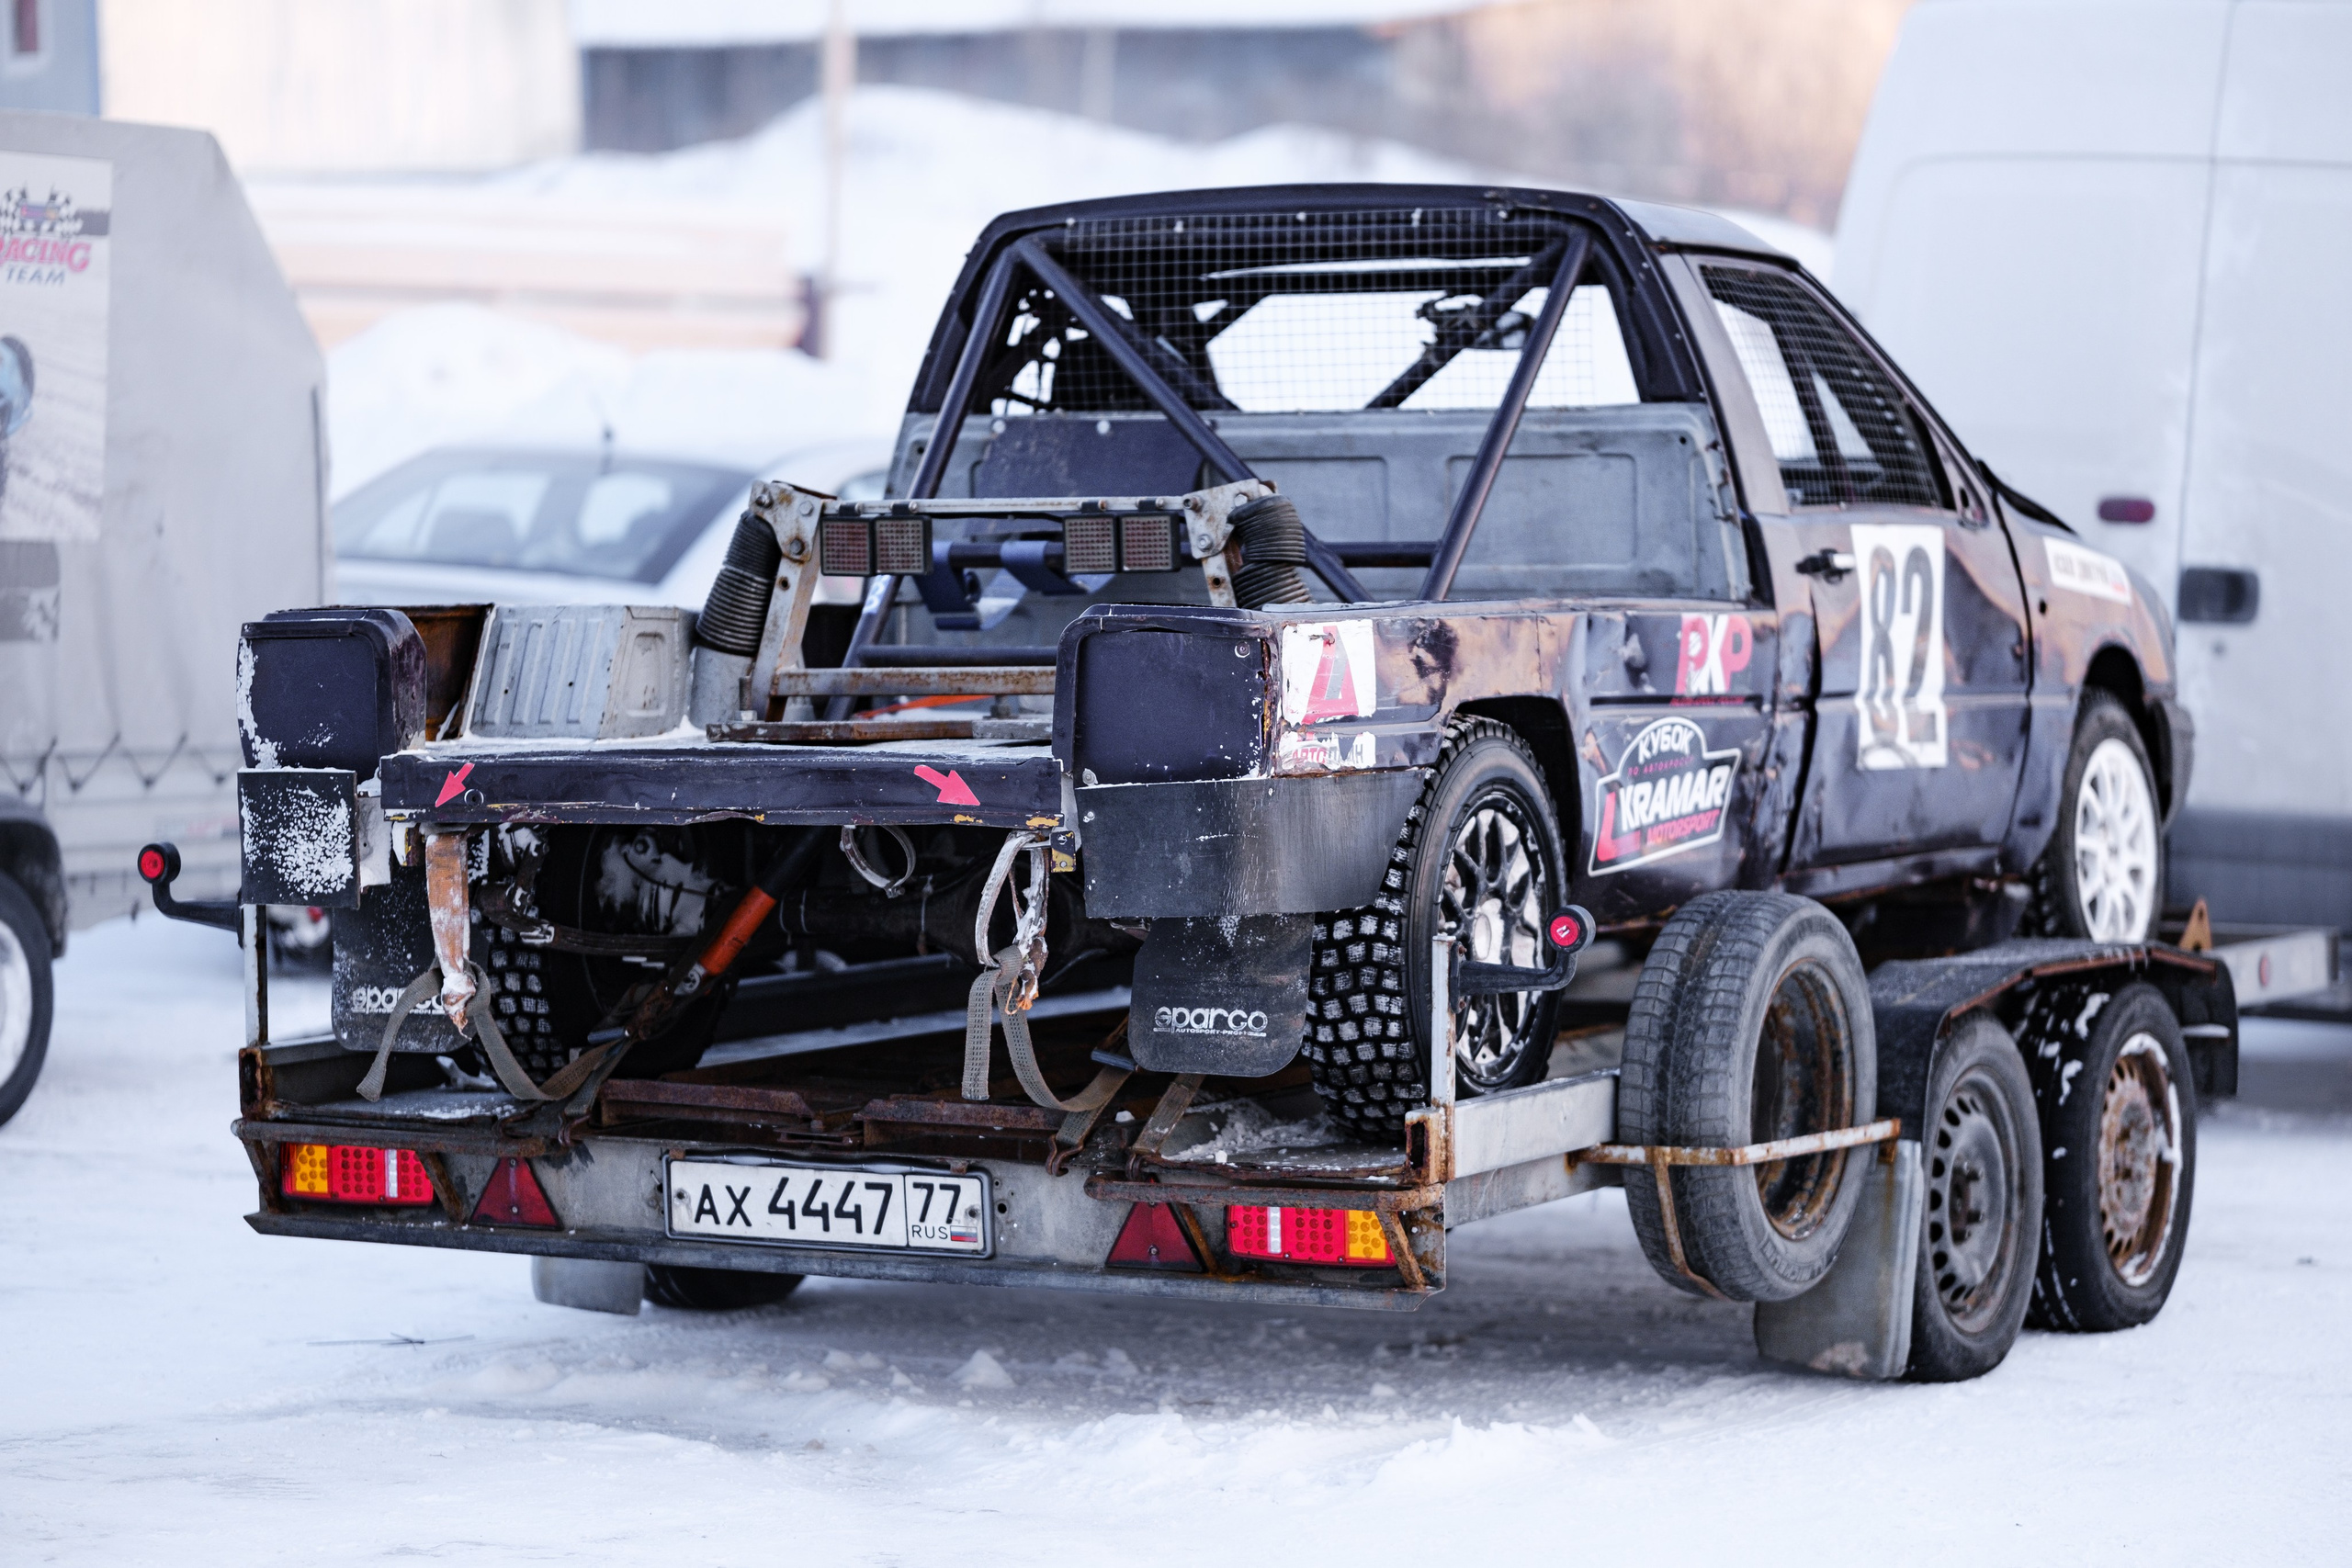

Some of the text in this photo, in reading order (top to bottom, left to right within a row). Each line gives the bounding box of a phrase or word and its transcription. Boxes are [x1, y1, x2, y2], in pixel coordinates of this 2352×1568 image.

[6, 266, 65, 287] TEAM
[1864, 545, 1939, 743] 82
[1638, 724, 1695, 764] КУБОК
[1619, 764, 1732, 833] KRAMAR
[1646, 808, 1722, 847] MOTORSPORT
[1154, 1006, 1269, 1033] sparco
[767, 1176, 893, 1235] 4447
[912, 1181, 962, 1224] 77
[911, 1224, 948, 1240] RUS
